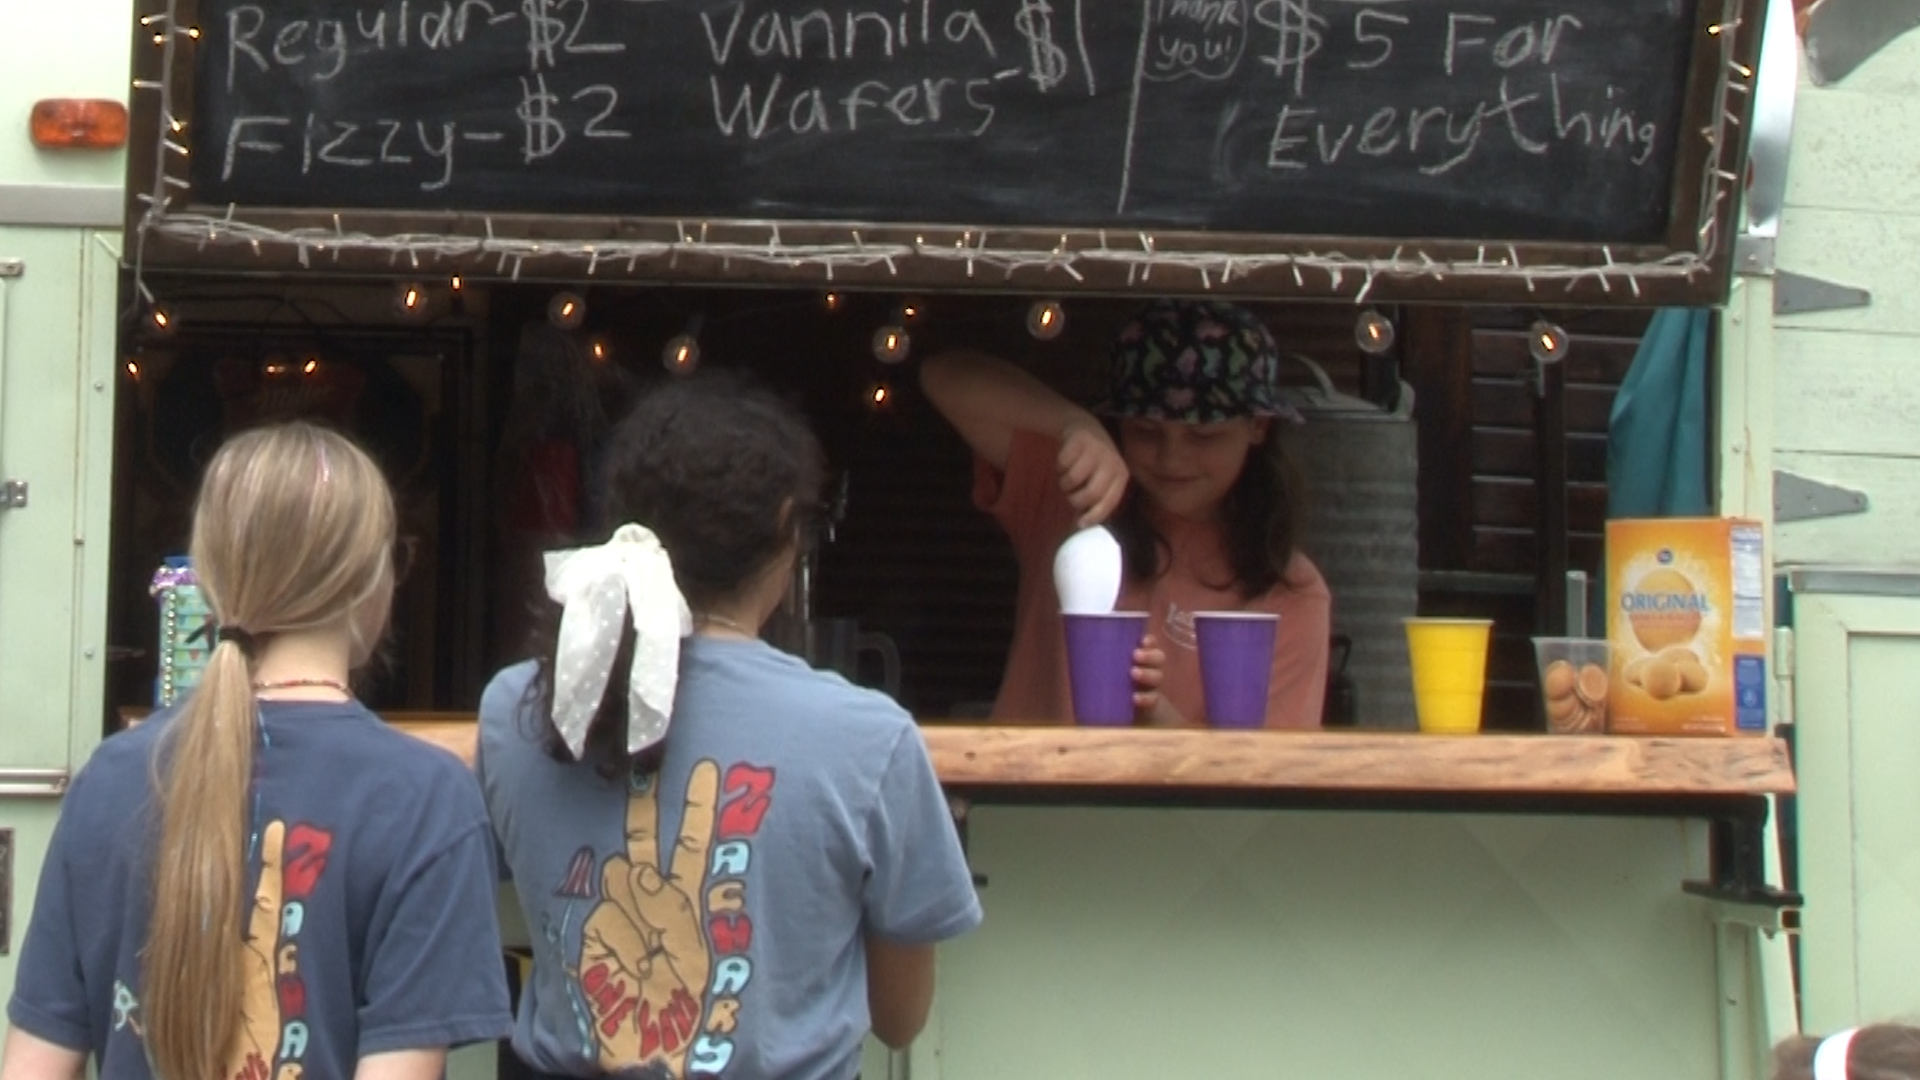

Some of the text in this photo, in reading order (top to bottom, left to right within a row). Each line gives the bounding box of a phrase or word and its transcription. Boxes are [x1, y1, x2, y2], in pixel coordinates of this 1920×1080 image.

[700, 0, 996, 64] Vannila
[1443, 14, 1582, 75] For
[1267, 73, 1656, 175] Everything
[1620, 591, 1710, 614] ORIGINAL
[583, 961, 638, 1038] ONE
